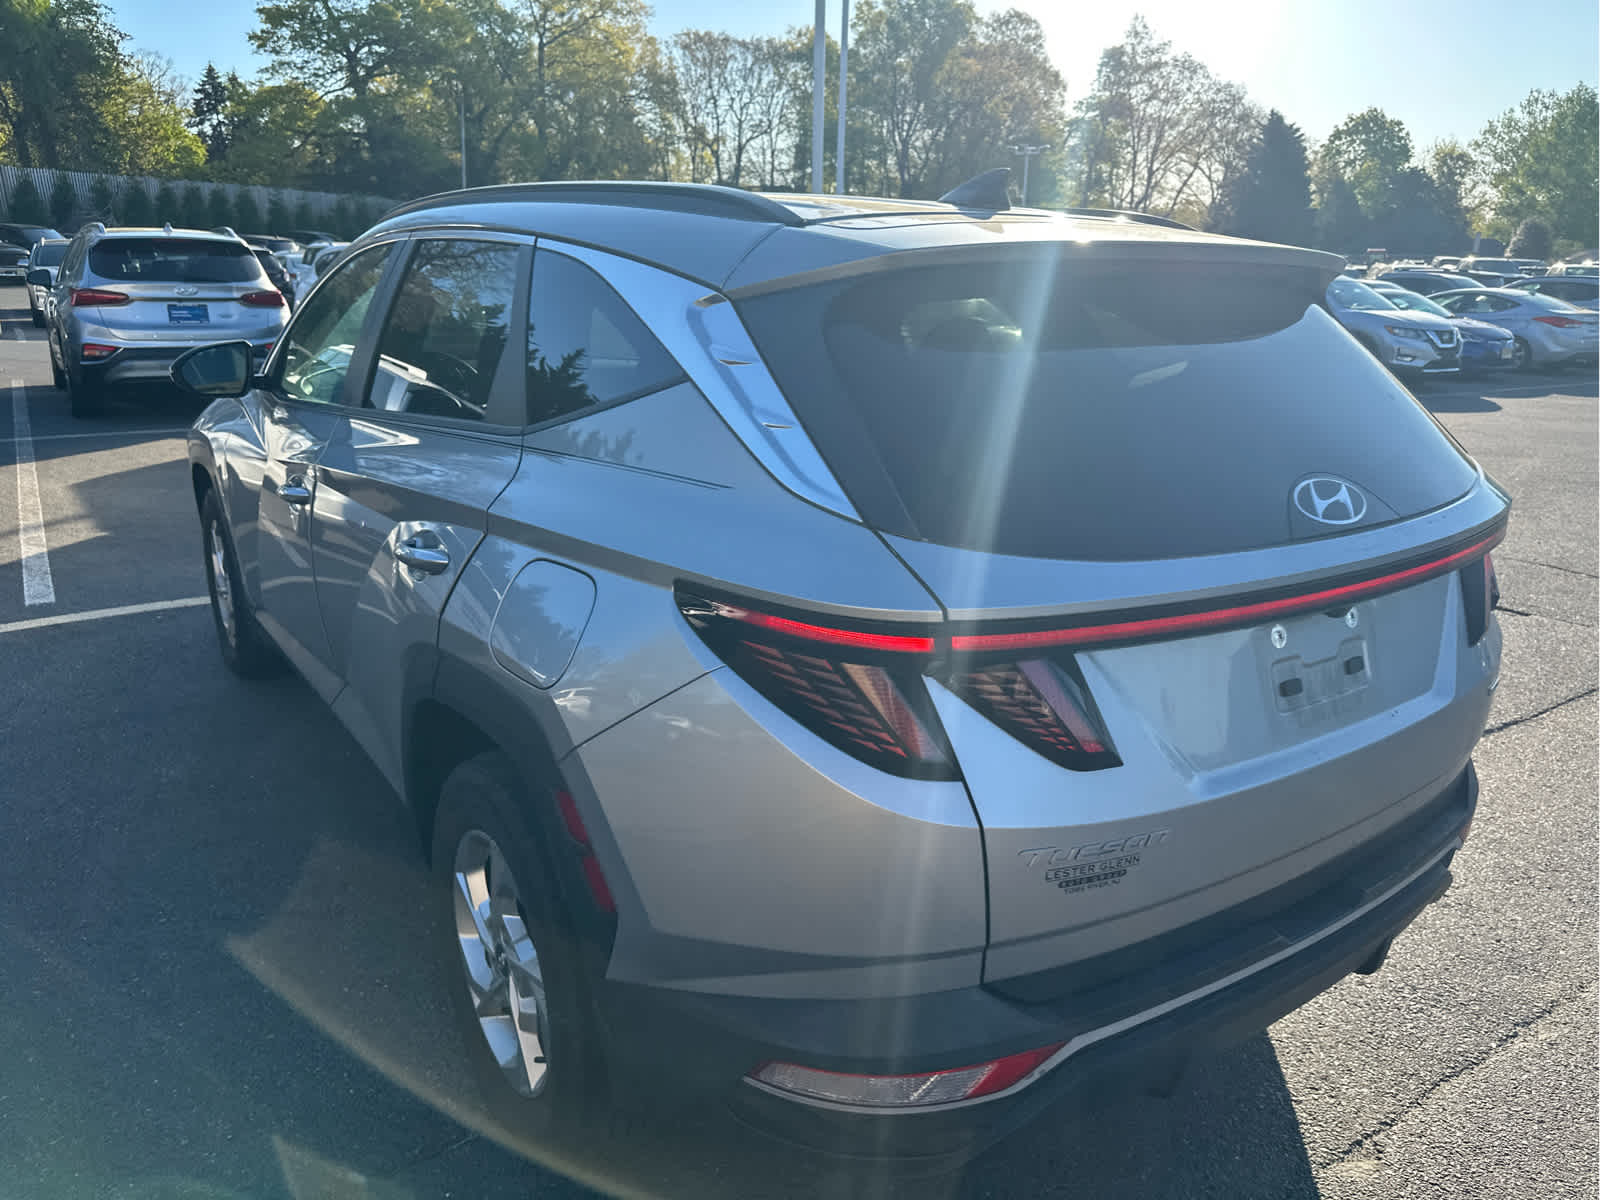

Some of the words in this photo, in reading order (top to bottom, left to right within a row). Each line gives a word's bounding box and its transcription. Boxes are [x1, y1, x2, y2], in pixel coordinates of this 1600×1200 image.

[1017, 829, 1170, 867] TUCSON
[1045, 864, 1096, 881] LESTER
[1099, 855, 1141, 871] GLENN
